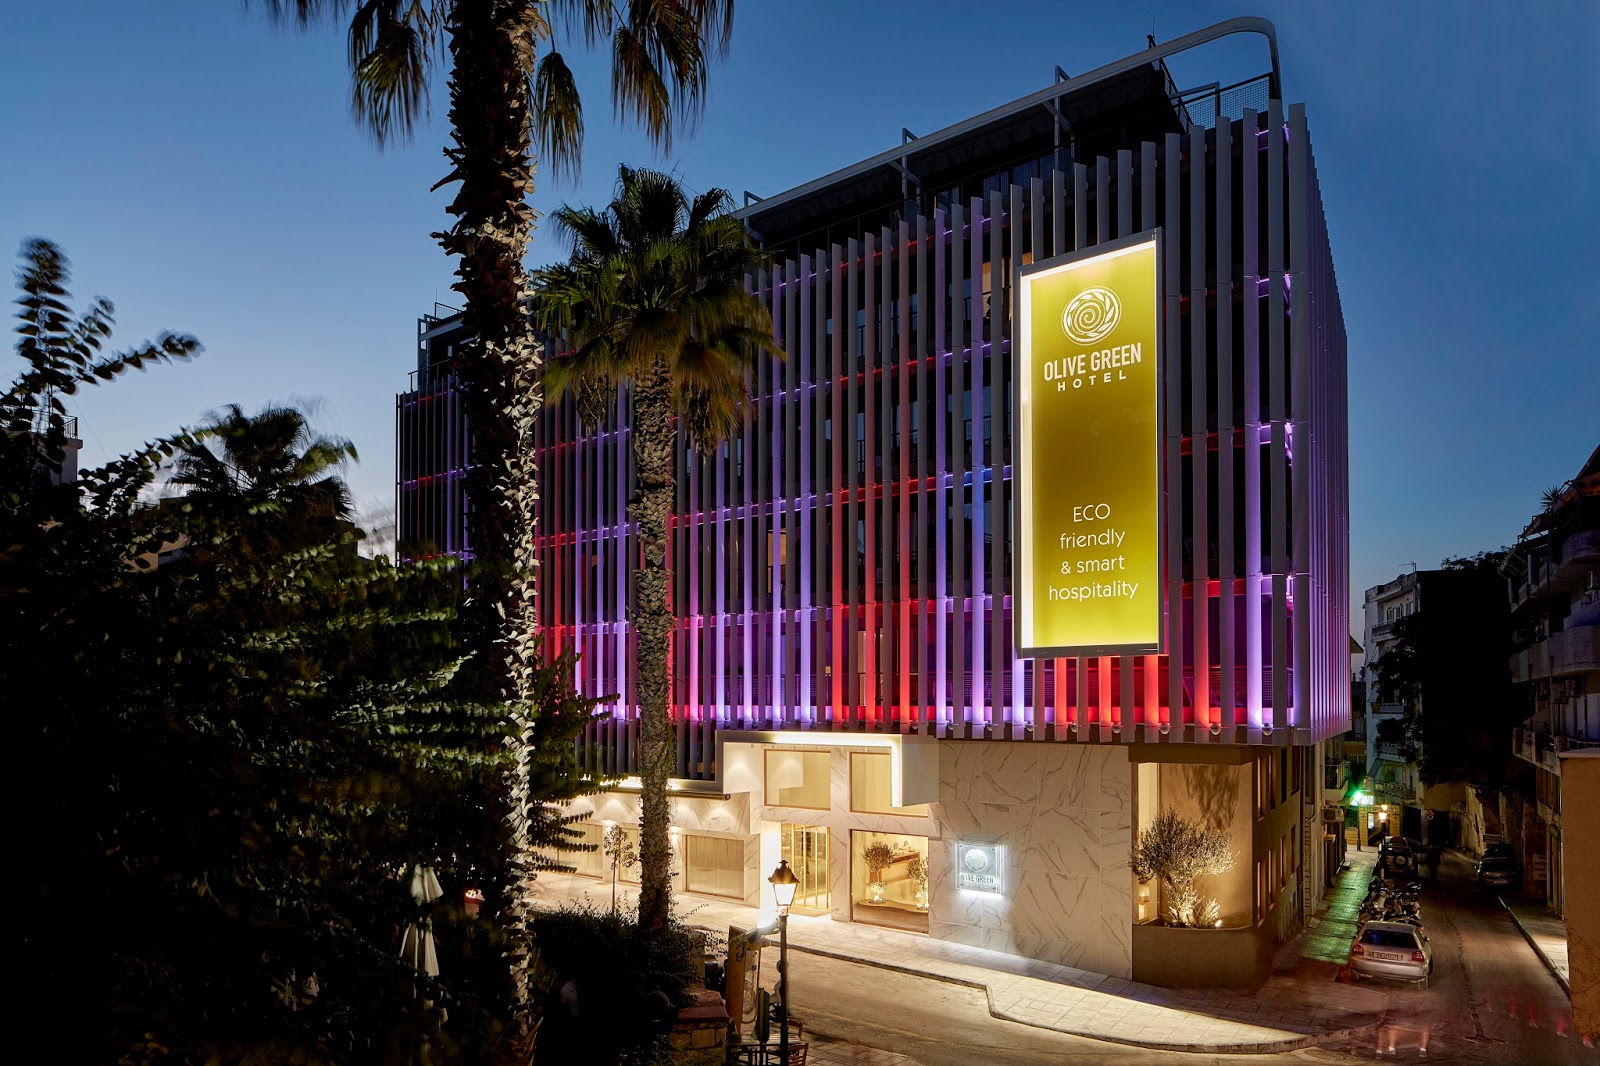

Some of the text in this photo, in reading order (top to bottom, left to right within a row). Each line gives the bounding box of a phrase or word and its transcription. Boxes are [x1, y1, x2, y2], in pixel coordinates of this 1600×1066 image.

[1044, 342, 1142, 381] OLIVE GREEN
[1057, 369, 1127, 392] HOTEL
[1073, 503, 1111, 522] ECO
[1060, 528, 1126, 549] friendly
[1061, 555, 1125, 574] & smart
[1049, 580, 1139, 602] hospitality
[975, 874, 994, 884] GREEN
